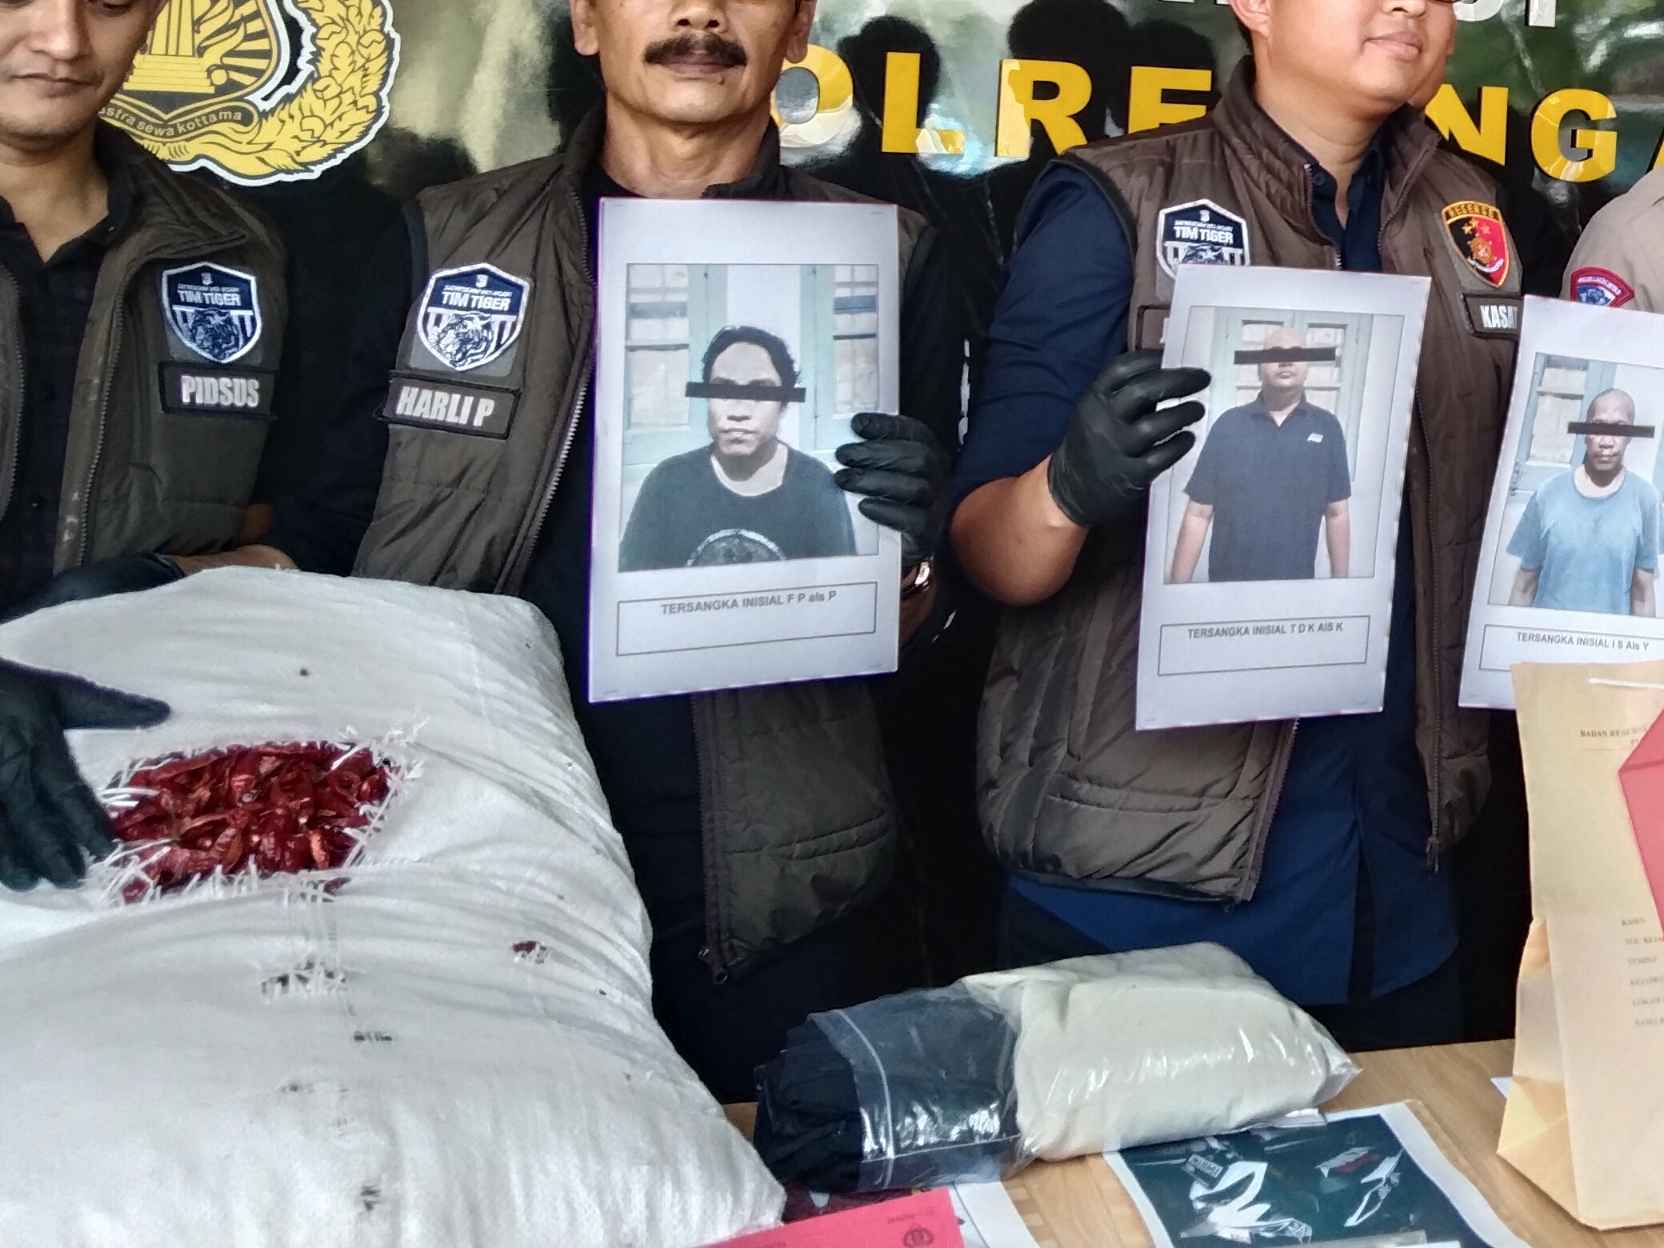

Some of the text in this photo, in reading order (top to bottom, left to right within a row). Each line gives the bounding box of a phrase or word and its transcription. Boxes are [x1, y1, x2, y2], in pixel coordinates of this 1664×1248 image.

[136, 120, 175, 137] sewa
[176, 110, 242, 135] kottama
[1173, 226, 1233, 244] TIM TIGER
[177, 290, 242, 306] TIM TIGER
[441, 291, 511, 312] TIM TIGER
[395, 386, 496, 428] HARLI P
[661, 598, 739, 615] TERSANGKA
[742, 595, 784, 608] INISIAL
[1188, 625, 1250, 640] TERSANGKA
[1252, 624, 1286, 636] INISIAL
[1517, 632, 1574, 645] TERSANGKA
[1576, 636, 1610, 648] INISIAL
